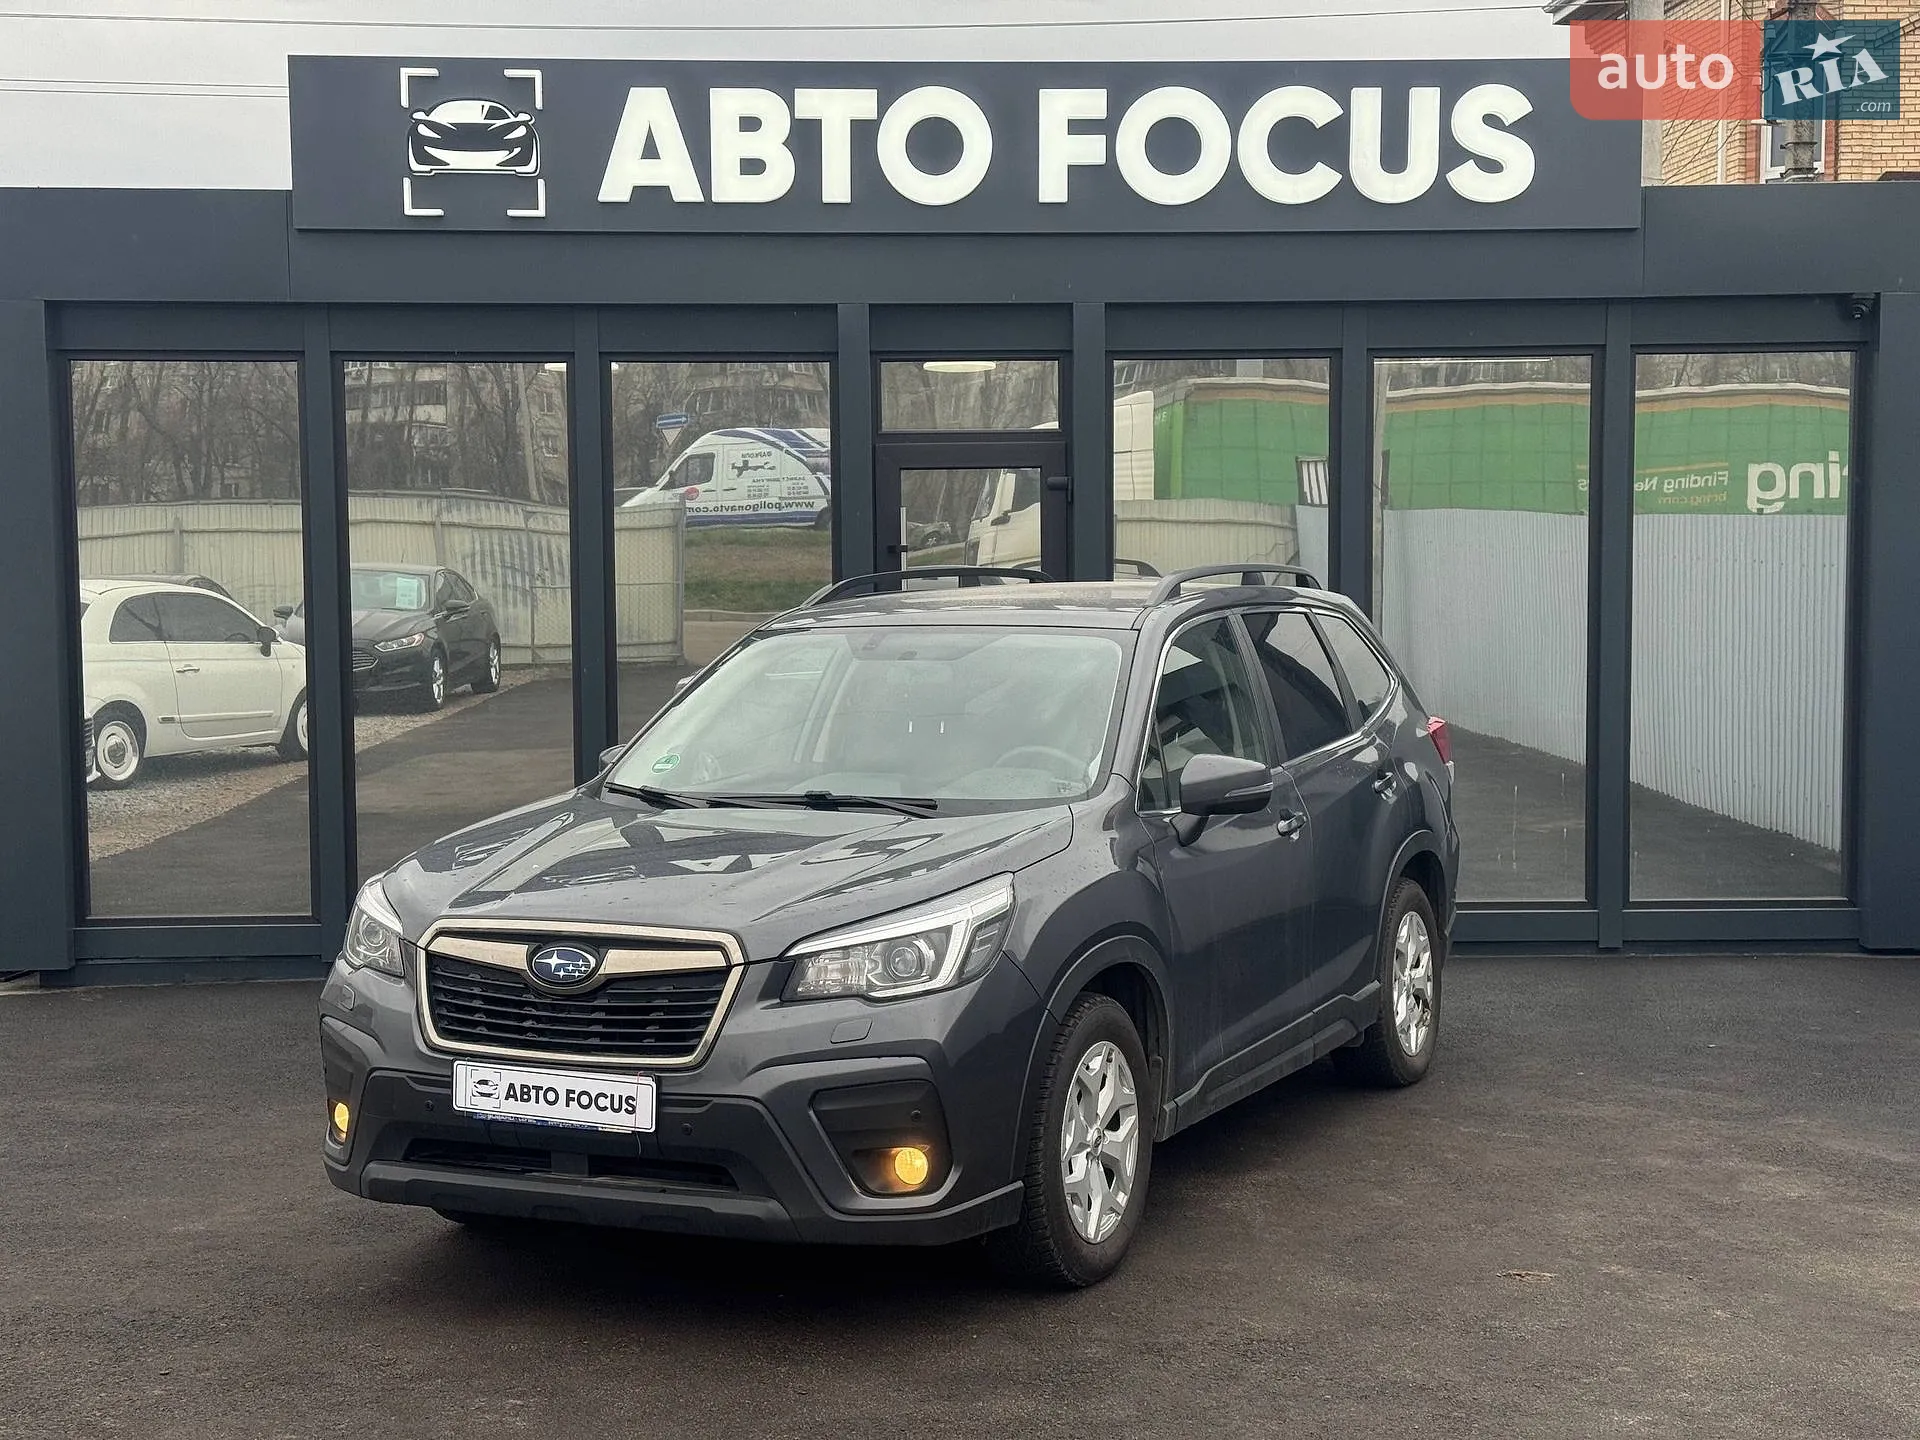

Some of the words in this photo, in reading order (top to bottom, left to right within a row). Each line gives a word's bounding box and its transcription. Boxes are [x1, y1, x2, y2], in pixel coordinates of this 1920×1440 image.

[597, 85, 993, 206] АВТО
[1038, 83, 1536, 206] FOCUS
[504, 1082, 560, 1106] АВТО
[565, 1088, 637, 1115] FOCUS
